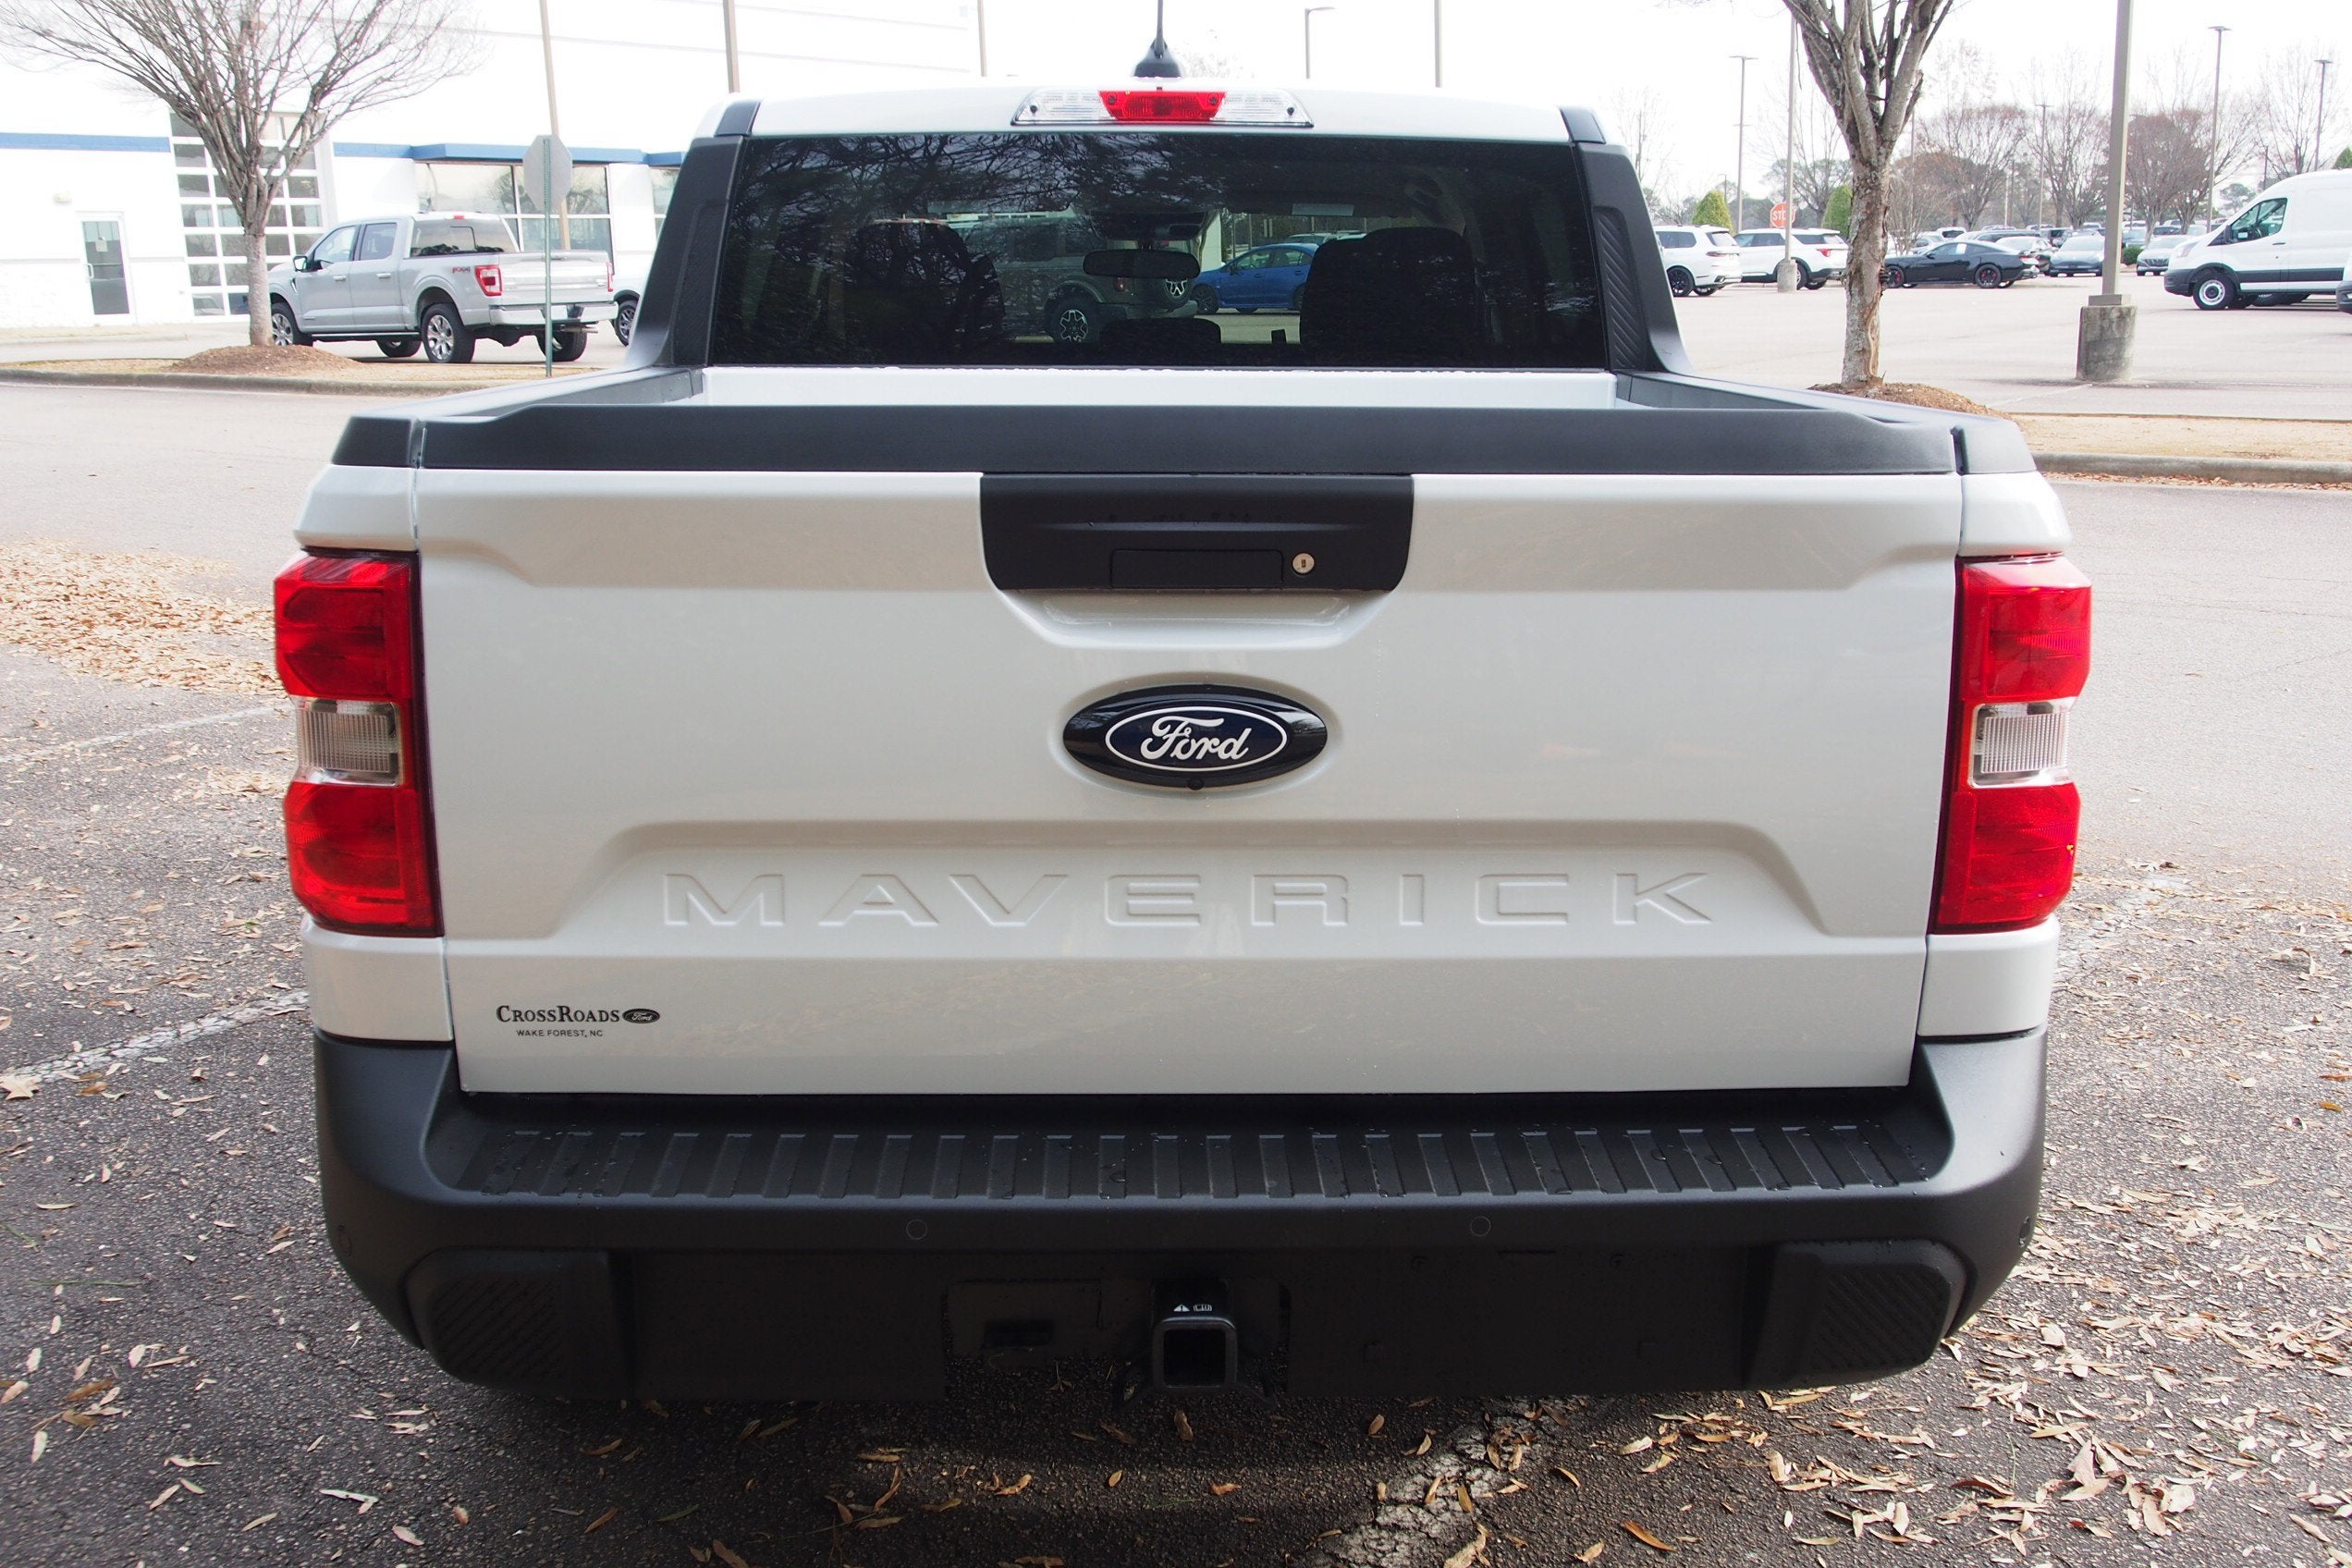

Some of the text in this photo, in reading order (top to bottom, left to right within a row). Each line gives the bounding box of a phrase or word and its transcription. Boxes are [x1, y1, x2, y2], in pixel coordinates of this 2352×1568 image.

[1140, 715, 1252, 760] Ford
[664, 873, 1712, 926] MAVERICK
[631, 1012, 652, 1022] Ford
[517, 1029, 603, 1038] WAKE FOREST, NC
